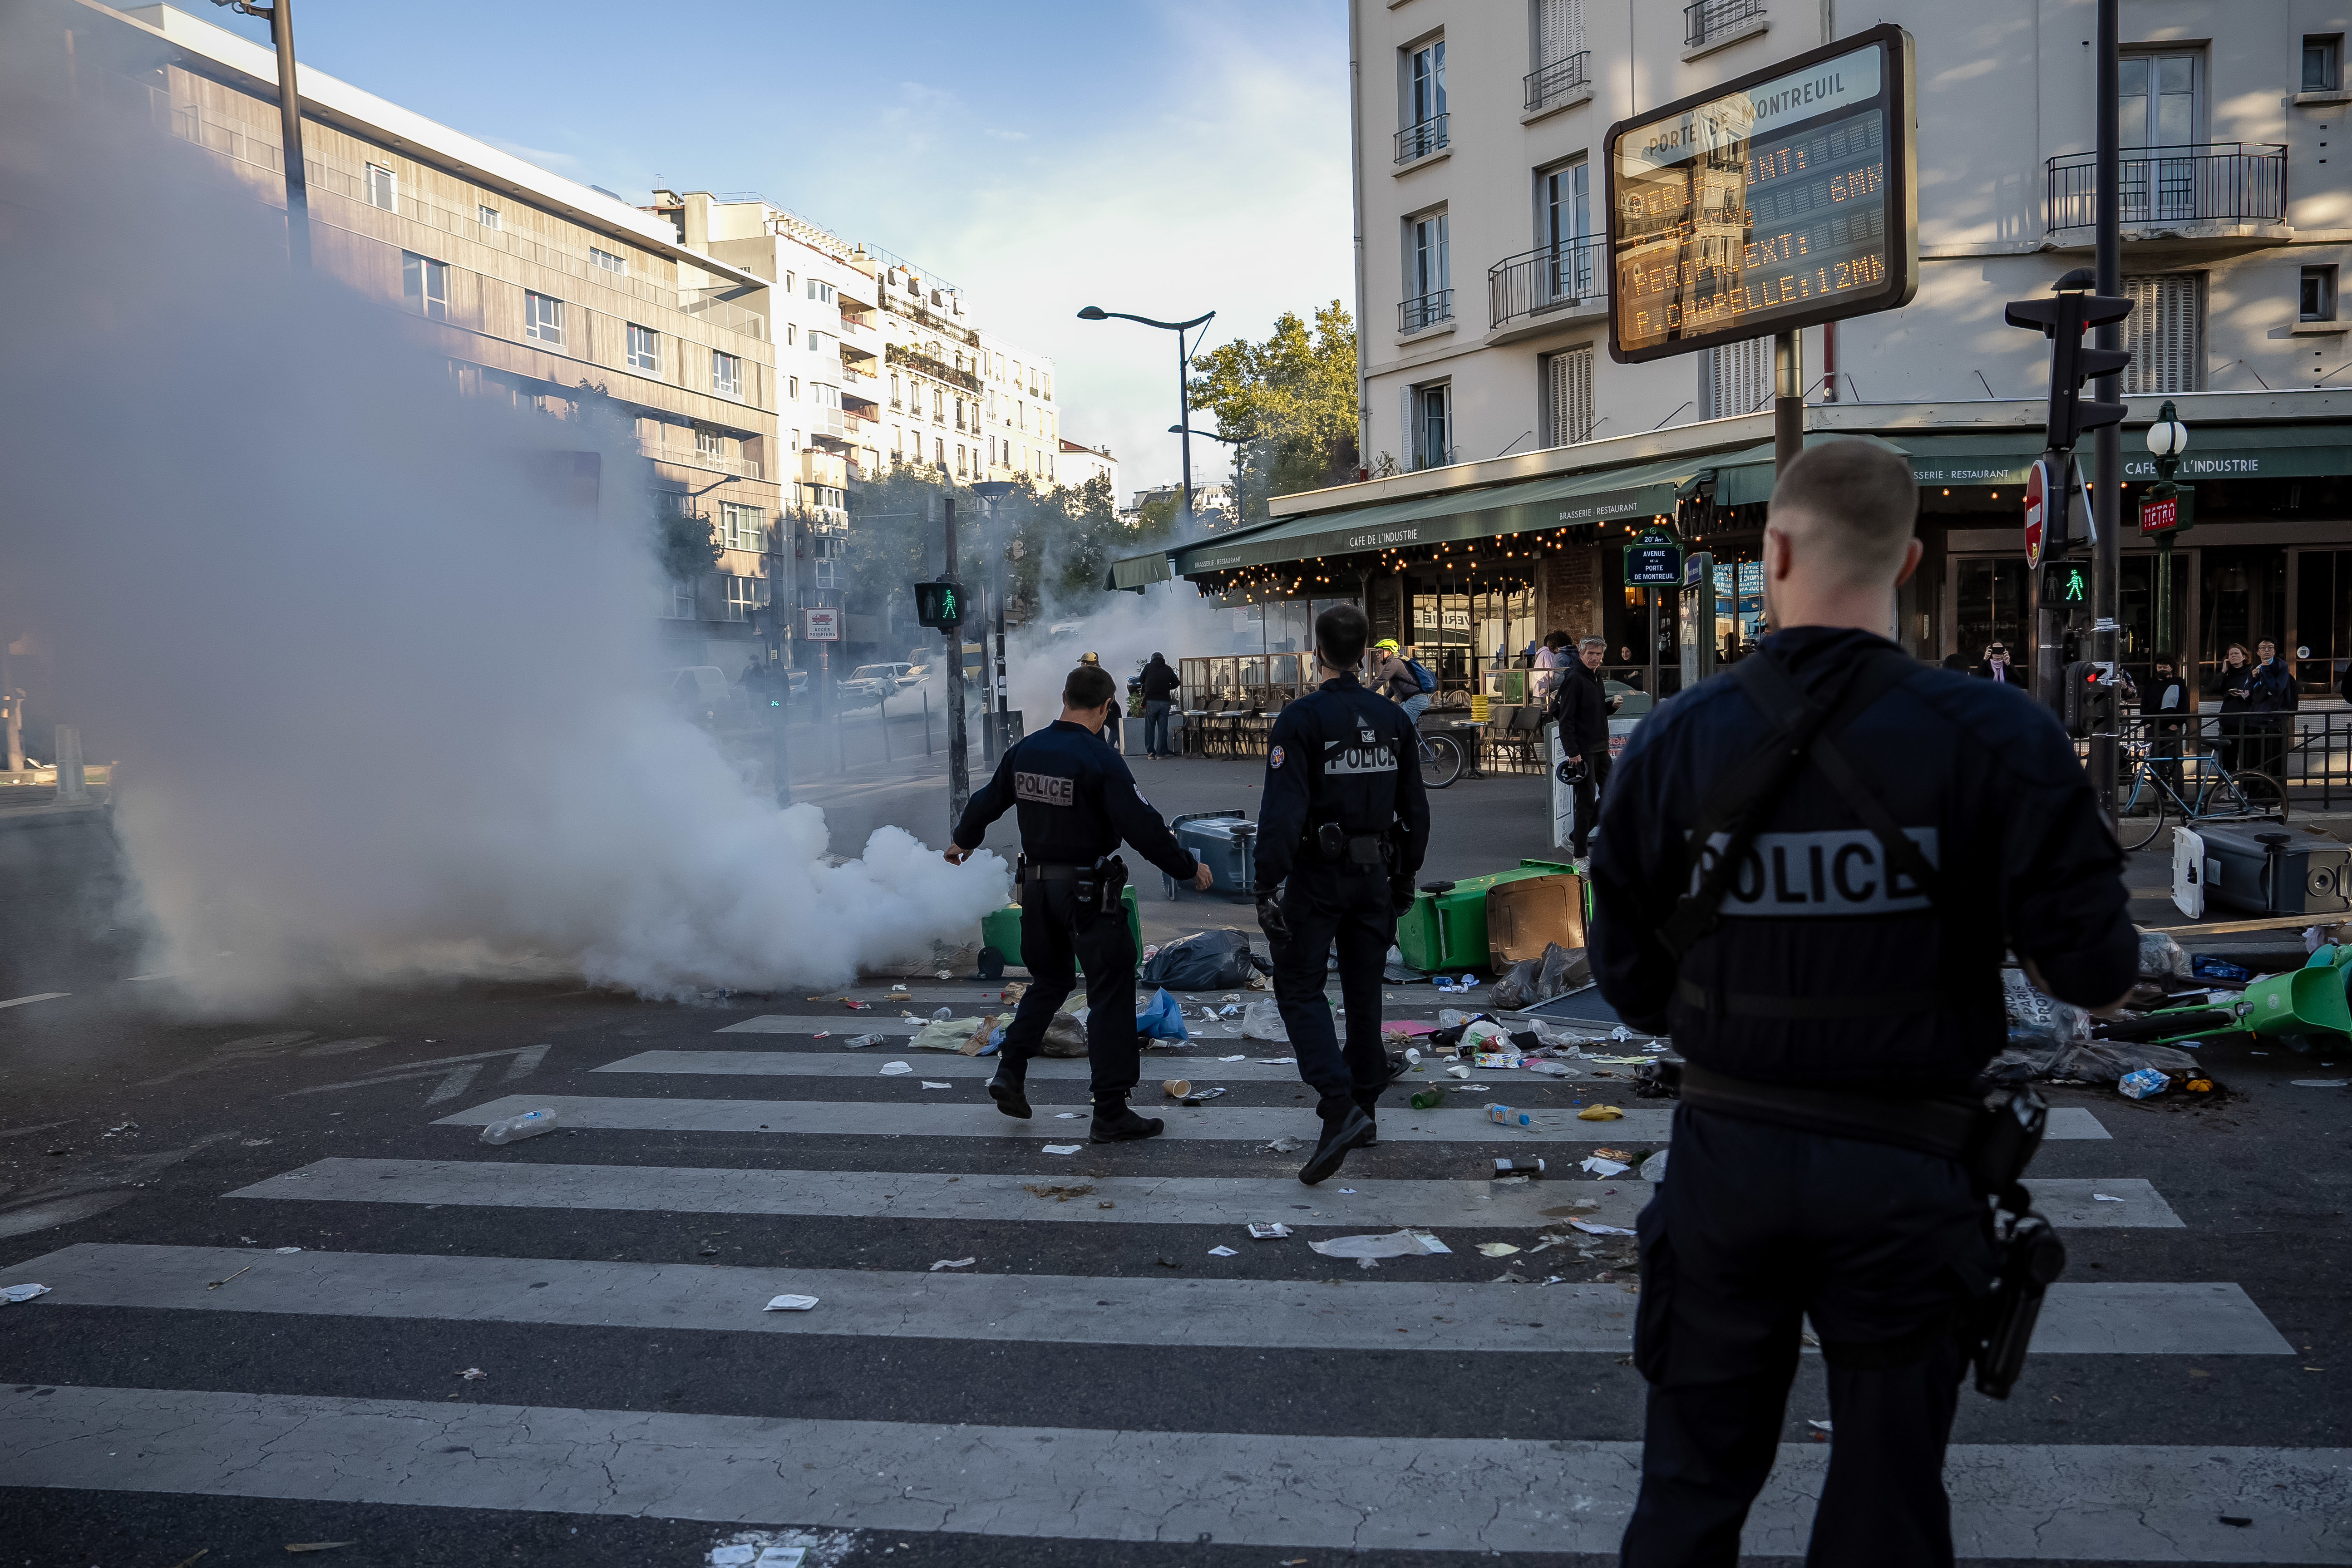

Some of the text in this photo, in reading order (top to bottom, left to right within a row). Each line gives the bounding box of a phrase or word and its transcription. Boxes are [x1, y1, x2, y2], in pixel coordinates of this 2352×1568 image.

[1650, 73, 1845, 156] PORTE DE MONTREUIL
[1913, 471, 1943, 479] SSERIE
[1952, 469, 2009, 478] RESTAURANT
[2125, 459, 2258, 474] CAFE L'INDUSTRIE
[1559, 508, 1592, 520] BRASSERIE
[1597, 503, 1637, 515] RESTAURANT
[1350, 529, 1417, 547] CAFE DE L'INDUSTRIE
[1194, 560, 1214, 568] BRASSERIE
[1217, 556, 1241, 565] RESTAURANT
[1016, 774, 1072, 798] POLICE
[2012, 986, 2036, 1015] PARIS
